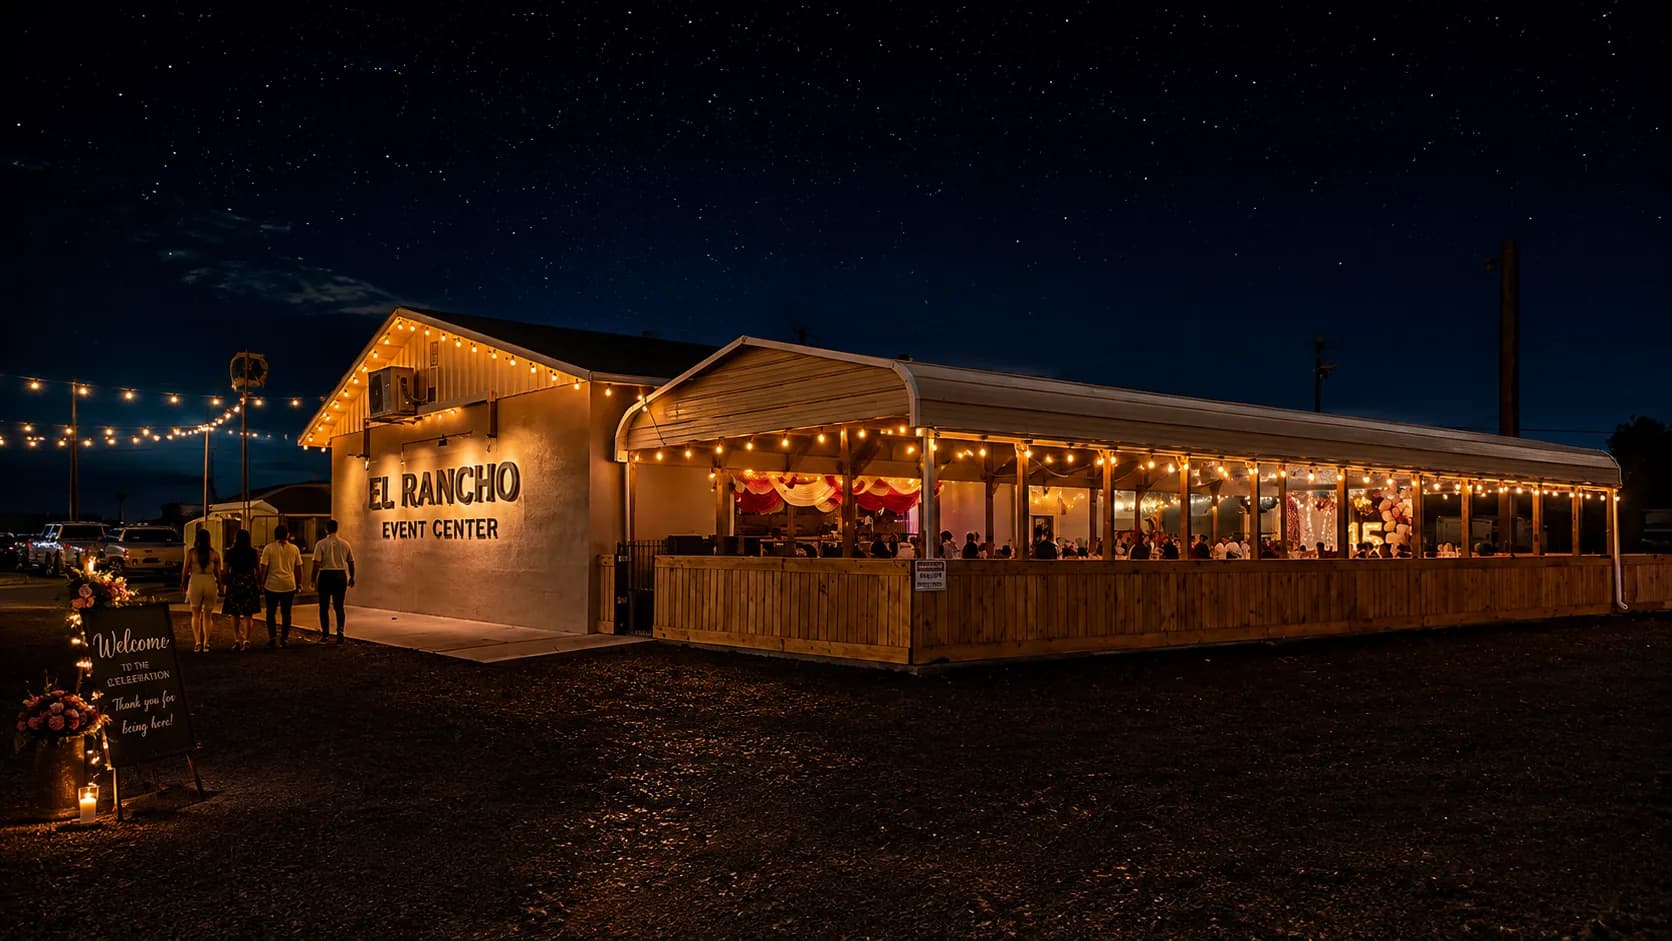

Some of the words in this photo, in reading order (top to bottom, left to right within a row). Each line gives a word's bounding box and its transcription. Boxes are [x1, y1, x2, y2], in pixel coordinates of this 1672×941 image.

[368, 477, 395, 510] EL
[402, 461, 520, 507] RANCHO
[383, 521, 427, 540] EVENT
[433, 518, 498, 539] CENTER
[1349, 522, 1383, 544] 15
[93, 628, 169, 658] Welcome
[121, 663, 132, 672] TO
[112, 694, 141, 712] Thank
[144, 698, 159, 712] you
[162, 690, 176, 709] for
[122, 719, 148, 737] being
[151, 713, 173, 729] here!
